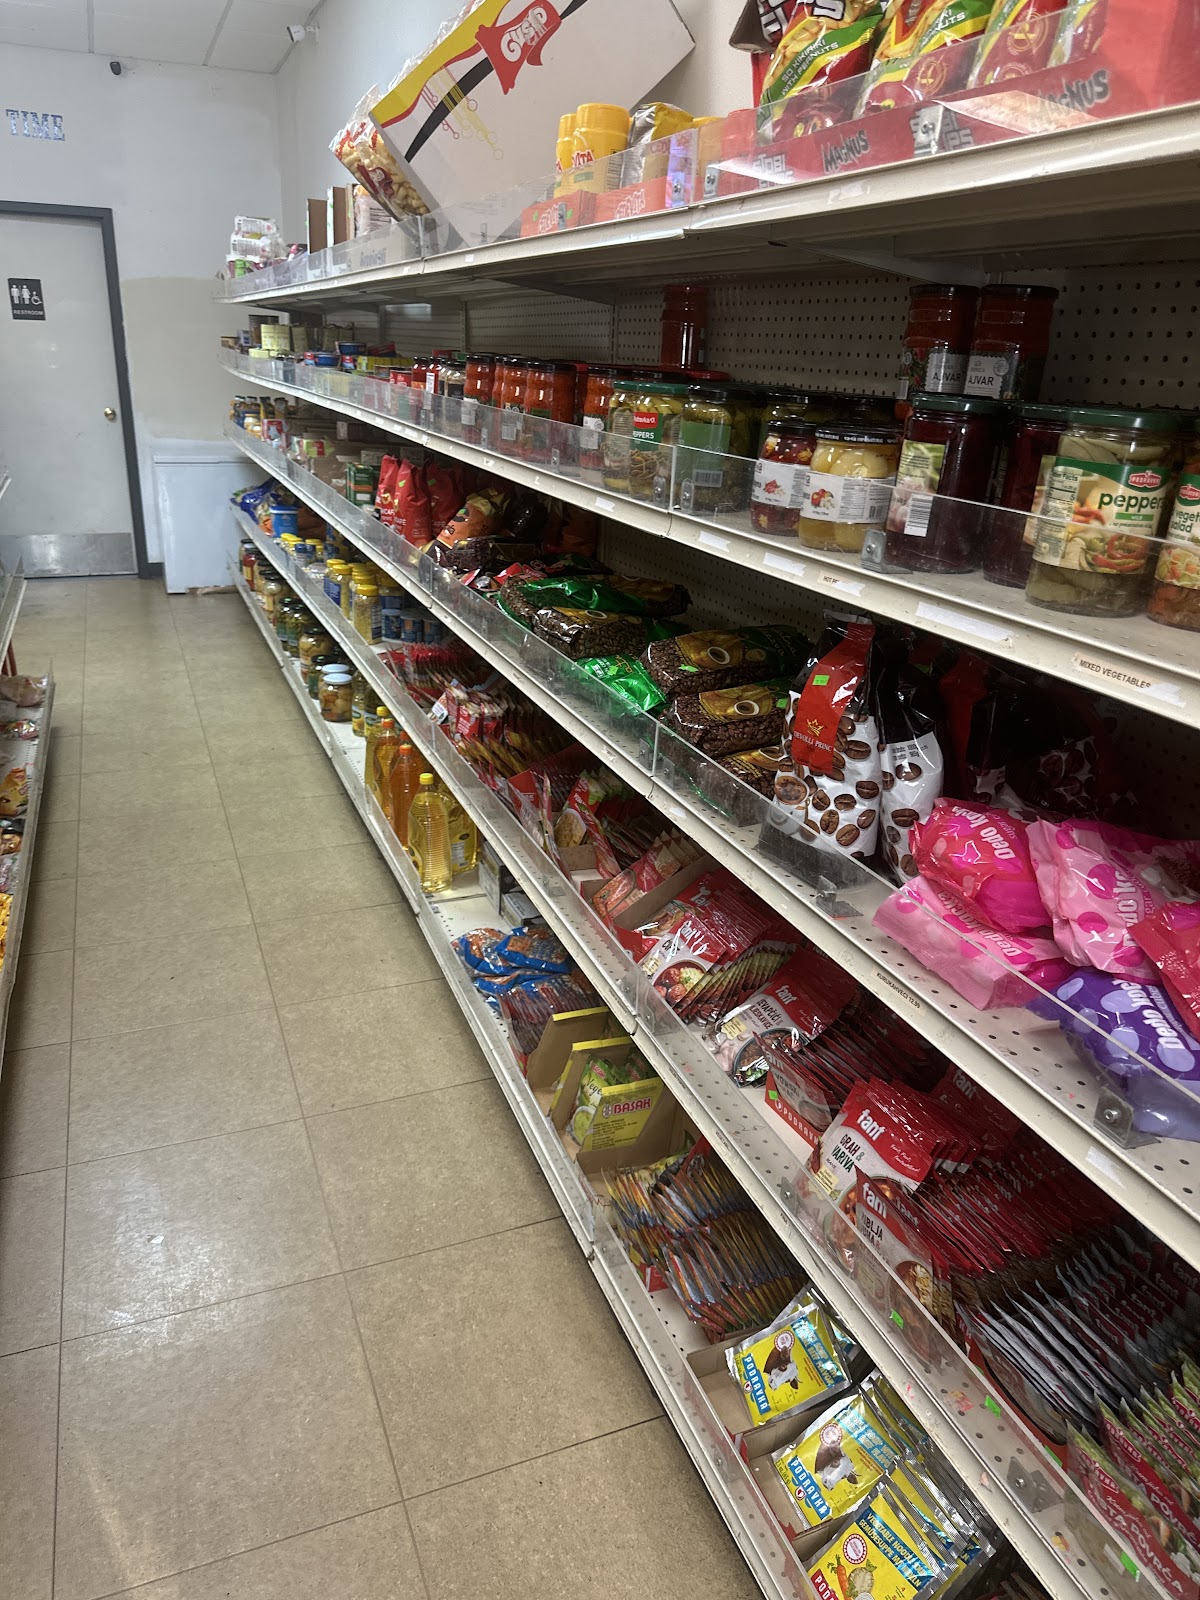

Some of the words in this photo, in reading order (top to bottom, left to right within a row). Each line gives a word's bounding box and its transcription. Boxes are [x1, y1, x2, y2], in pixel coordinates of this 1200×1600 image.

[6, 109, 65, 141] TIME
[1175, 510, 1200, 523] veget
[1079, 660, 1101, 673] MIXED
[586, 1072, 602, 1097] Vege
[784, 1107, 819, 1145] PODRAVK
[857, 1108, 886, 1141] fant
[831, 1144, 854, 1173] VARIVA
[840, 1134, 860, 1156] GRAH
[743, 1356, 769, 1410] PODRAVKA
[790, 1459, 830, 1515] PODRAVKA
[865, 1513, 896, 1544] VEGETABLE
[1150, 1492, 1200, 1545] POVRĆ
